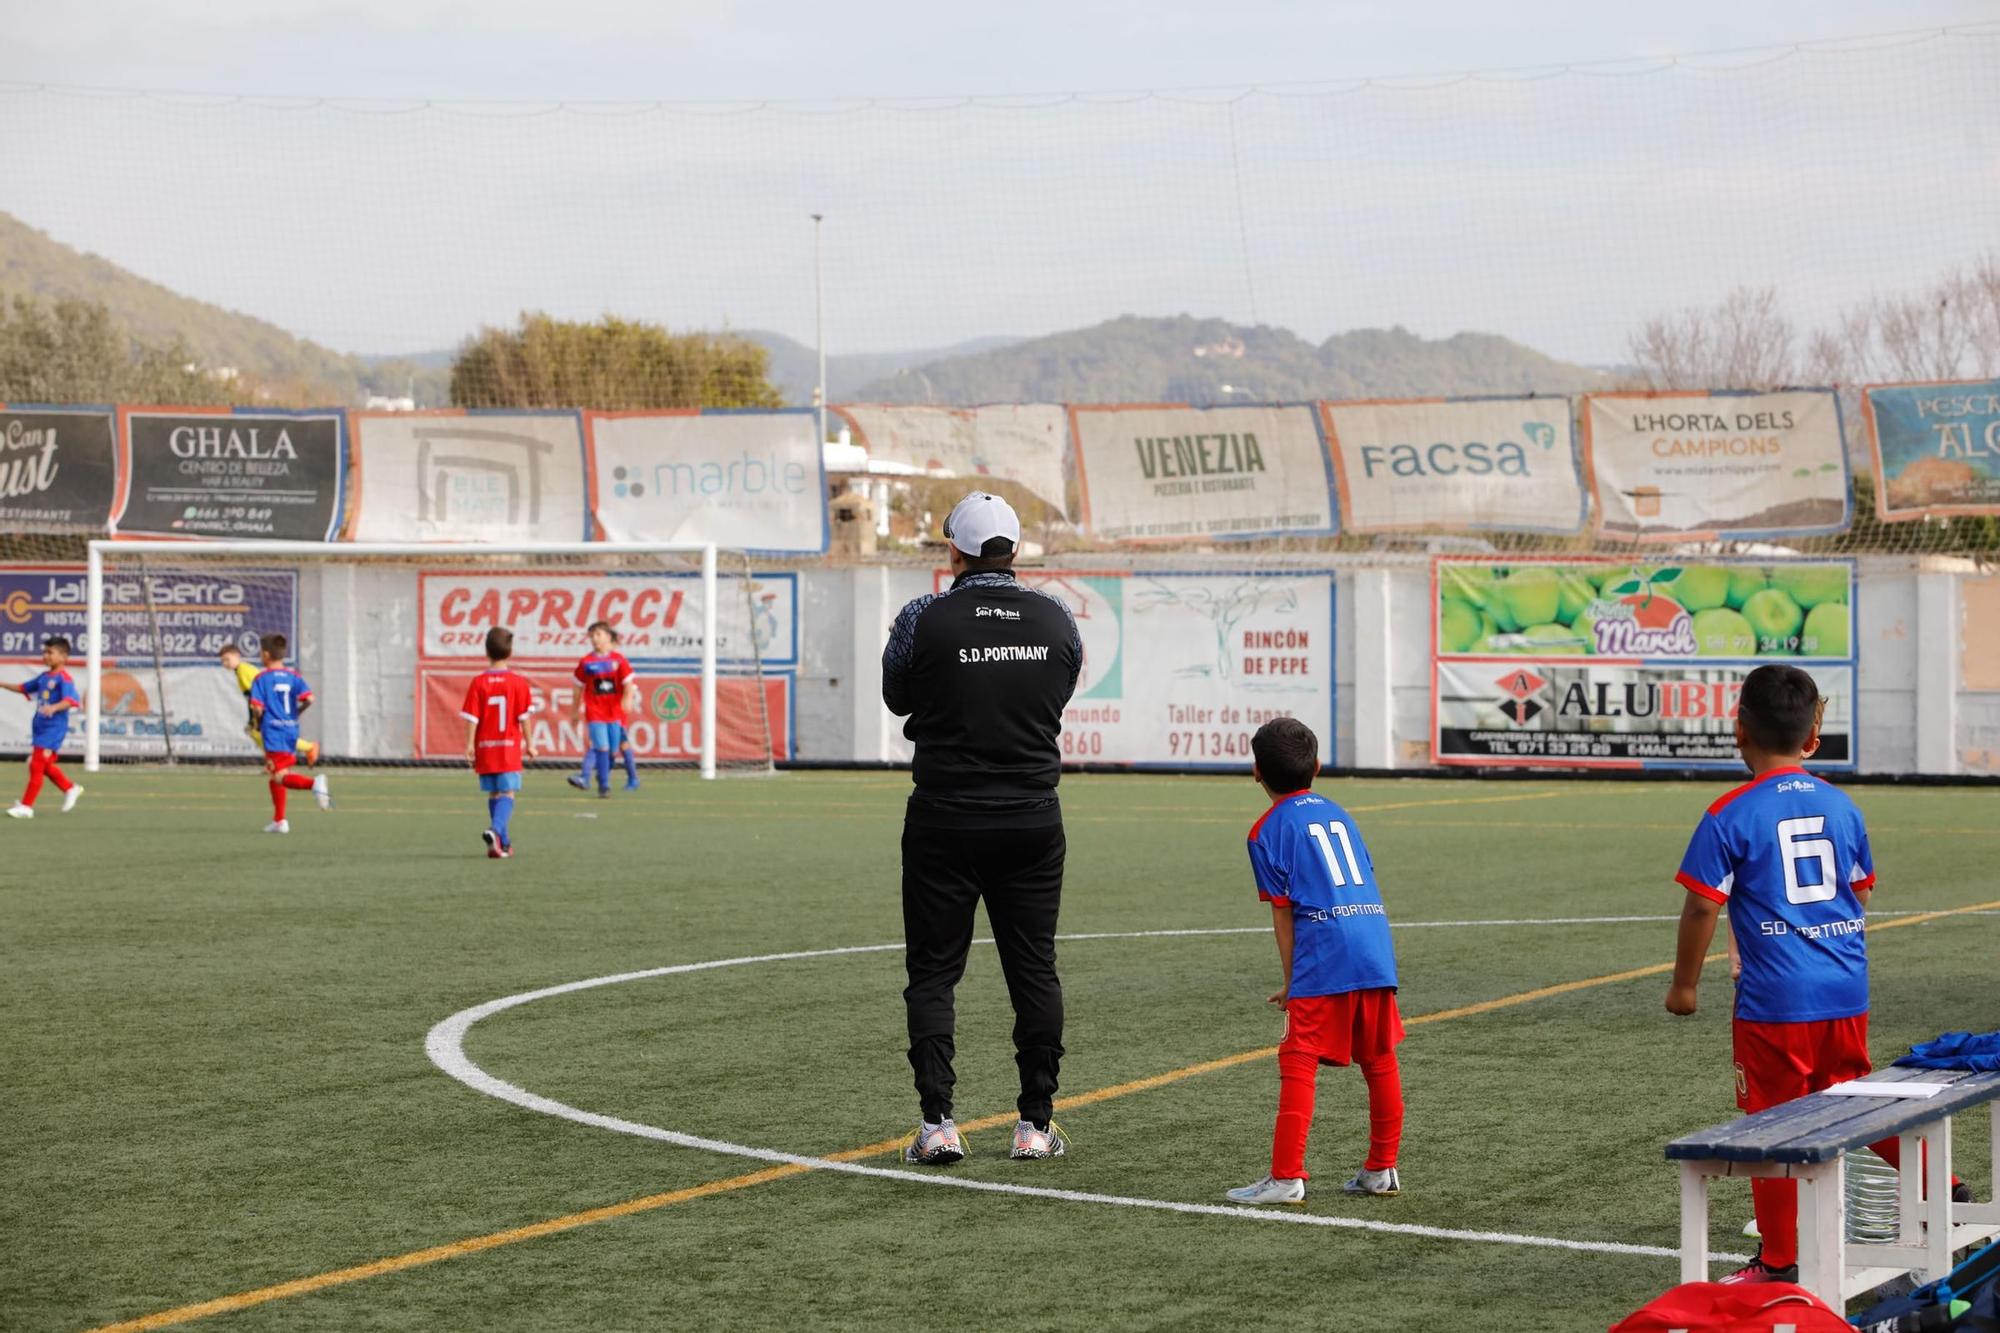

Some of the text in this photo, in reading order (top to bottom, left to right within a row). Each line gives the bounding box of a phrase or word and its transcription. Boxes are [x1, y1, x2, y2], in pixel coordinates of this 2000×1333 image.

[1632, 411, 1795, 433] L'HORTA DELS
[169, 426, 298, 459] GHALA
[1652, 436, 1782, 458] CAMPIONS
[1135, 432, 1266, 479] VENEZIA
[178, 460, 289, 476] CENTRO DE BELLEZA
[655, 449, 807, 496] marble
[150, 579, 244, 604] Serra
[440, 587, 684, 629] CAPRICCI
[2, 632, 34, 651] 971
[162, 633, 197, 652] 922
[439, 631, 487, 646] GRI
[538, 632, 650, 646] PIZZRIA
[1243, 628, 1309, 649] RINCÓN
[1594, 615, 1698, 654] March
[1761, 636, 1778, 650] 34
[959, 646, 1049, 663] S.D.PORTMANY
[1243, 657, 1310, 675] DE PEPE
[1558, 681, 1742, 718] ALUIBIZ
[1064, 704, 1121, 723] mundo
[1168, 704, 1214, 724] Taller
[1221, 705, 1240, 724] de
[1169, 732, 1250, 757] 971340
[1308, 820, 1365, 888] 11
[1777, 815, 1838, 906] 6
[1760, 920, 1788, 935] SD
